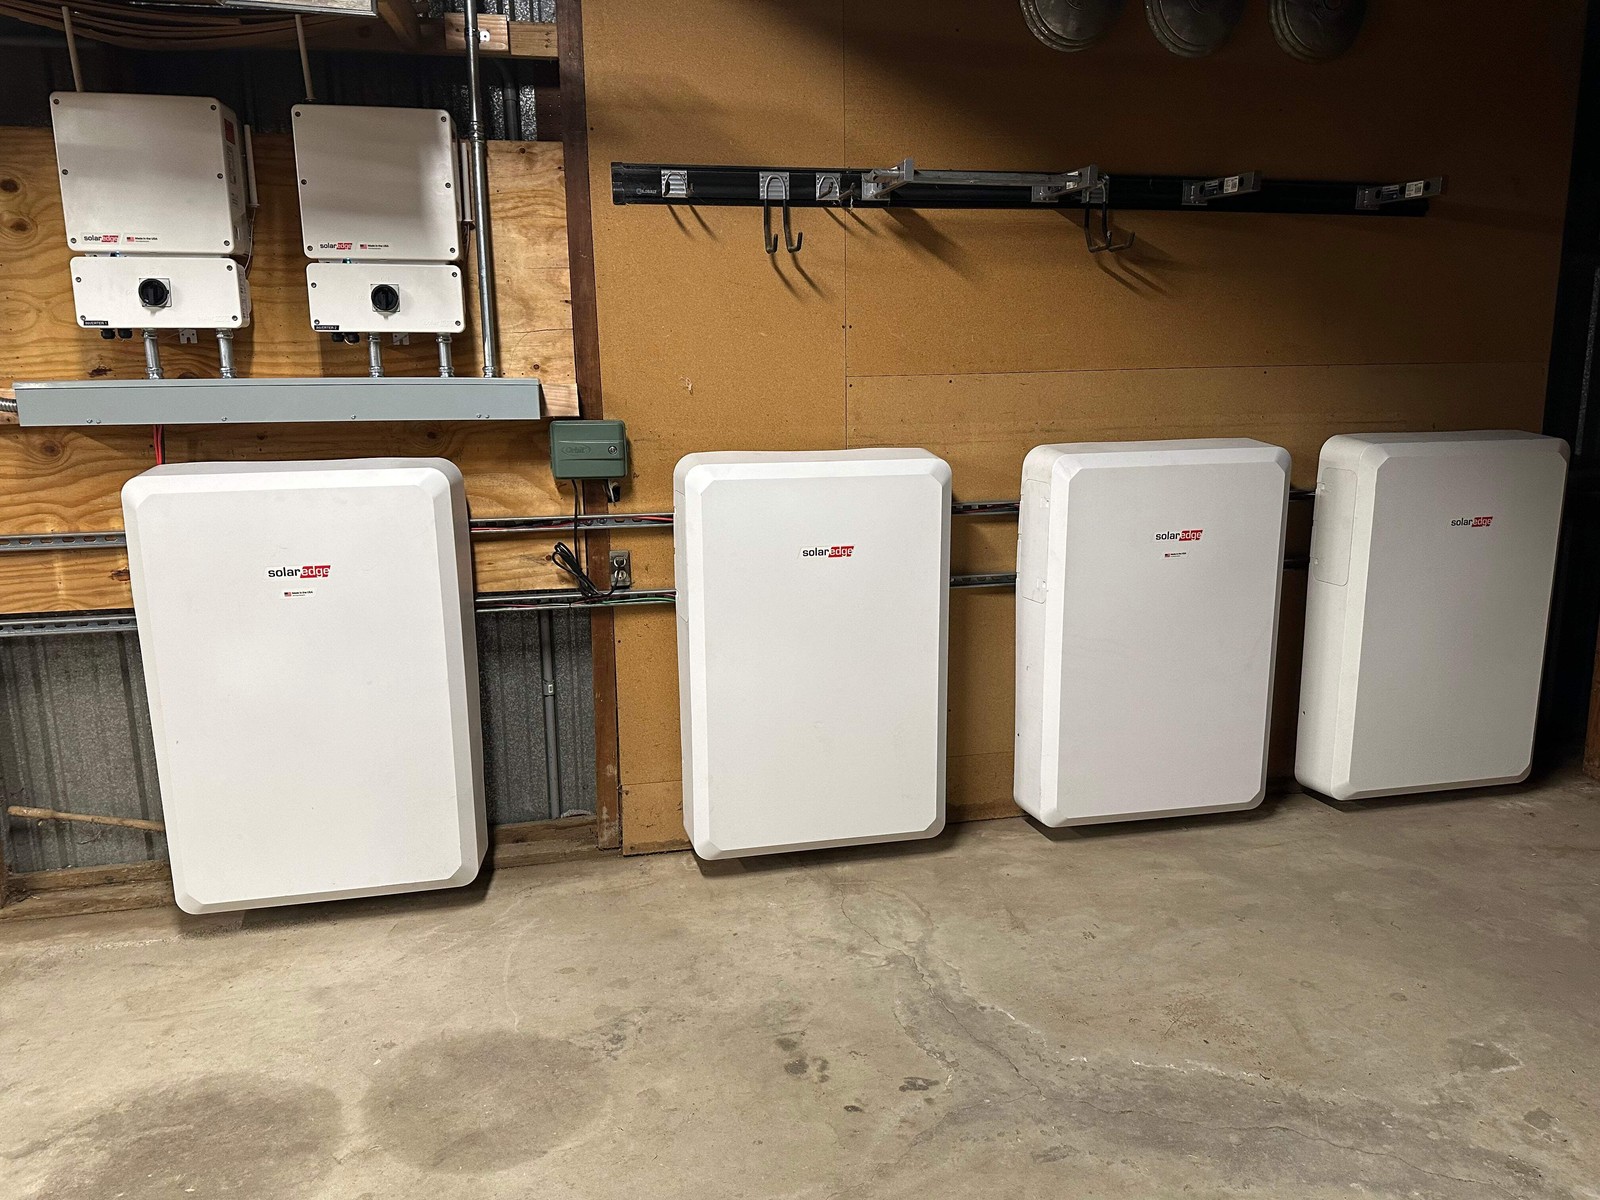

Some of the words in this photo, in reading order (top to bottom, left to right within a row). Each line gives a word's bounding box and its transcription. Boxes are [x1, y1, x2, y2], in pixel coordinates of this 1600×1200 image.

[1451, 517, 1493, 527] solaredge
[1155, 530, 1203, 541] solaredge
[802, 546, 854, 558] solaredge
[268, 565, 331, 578] solaredge
